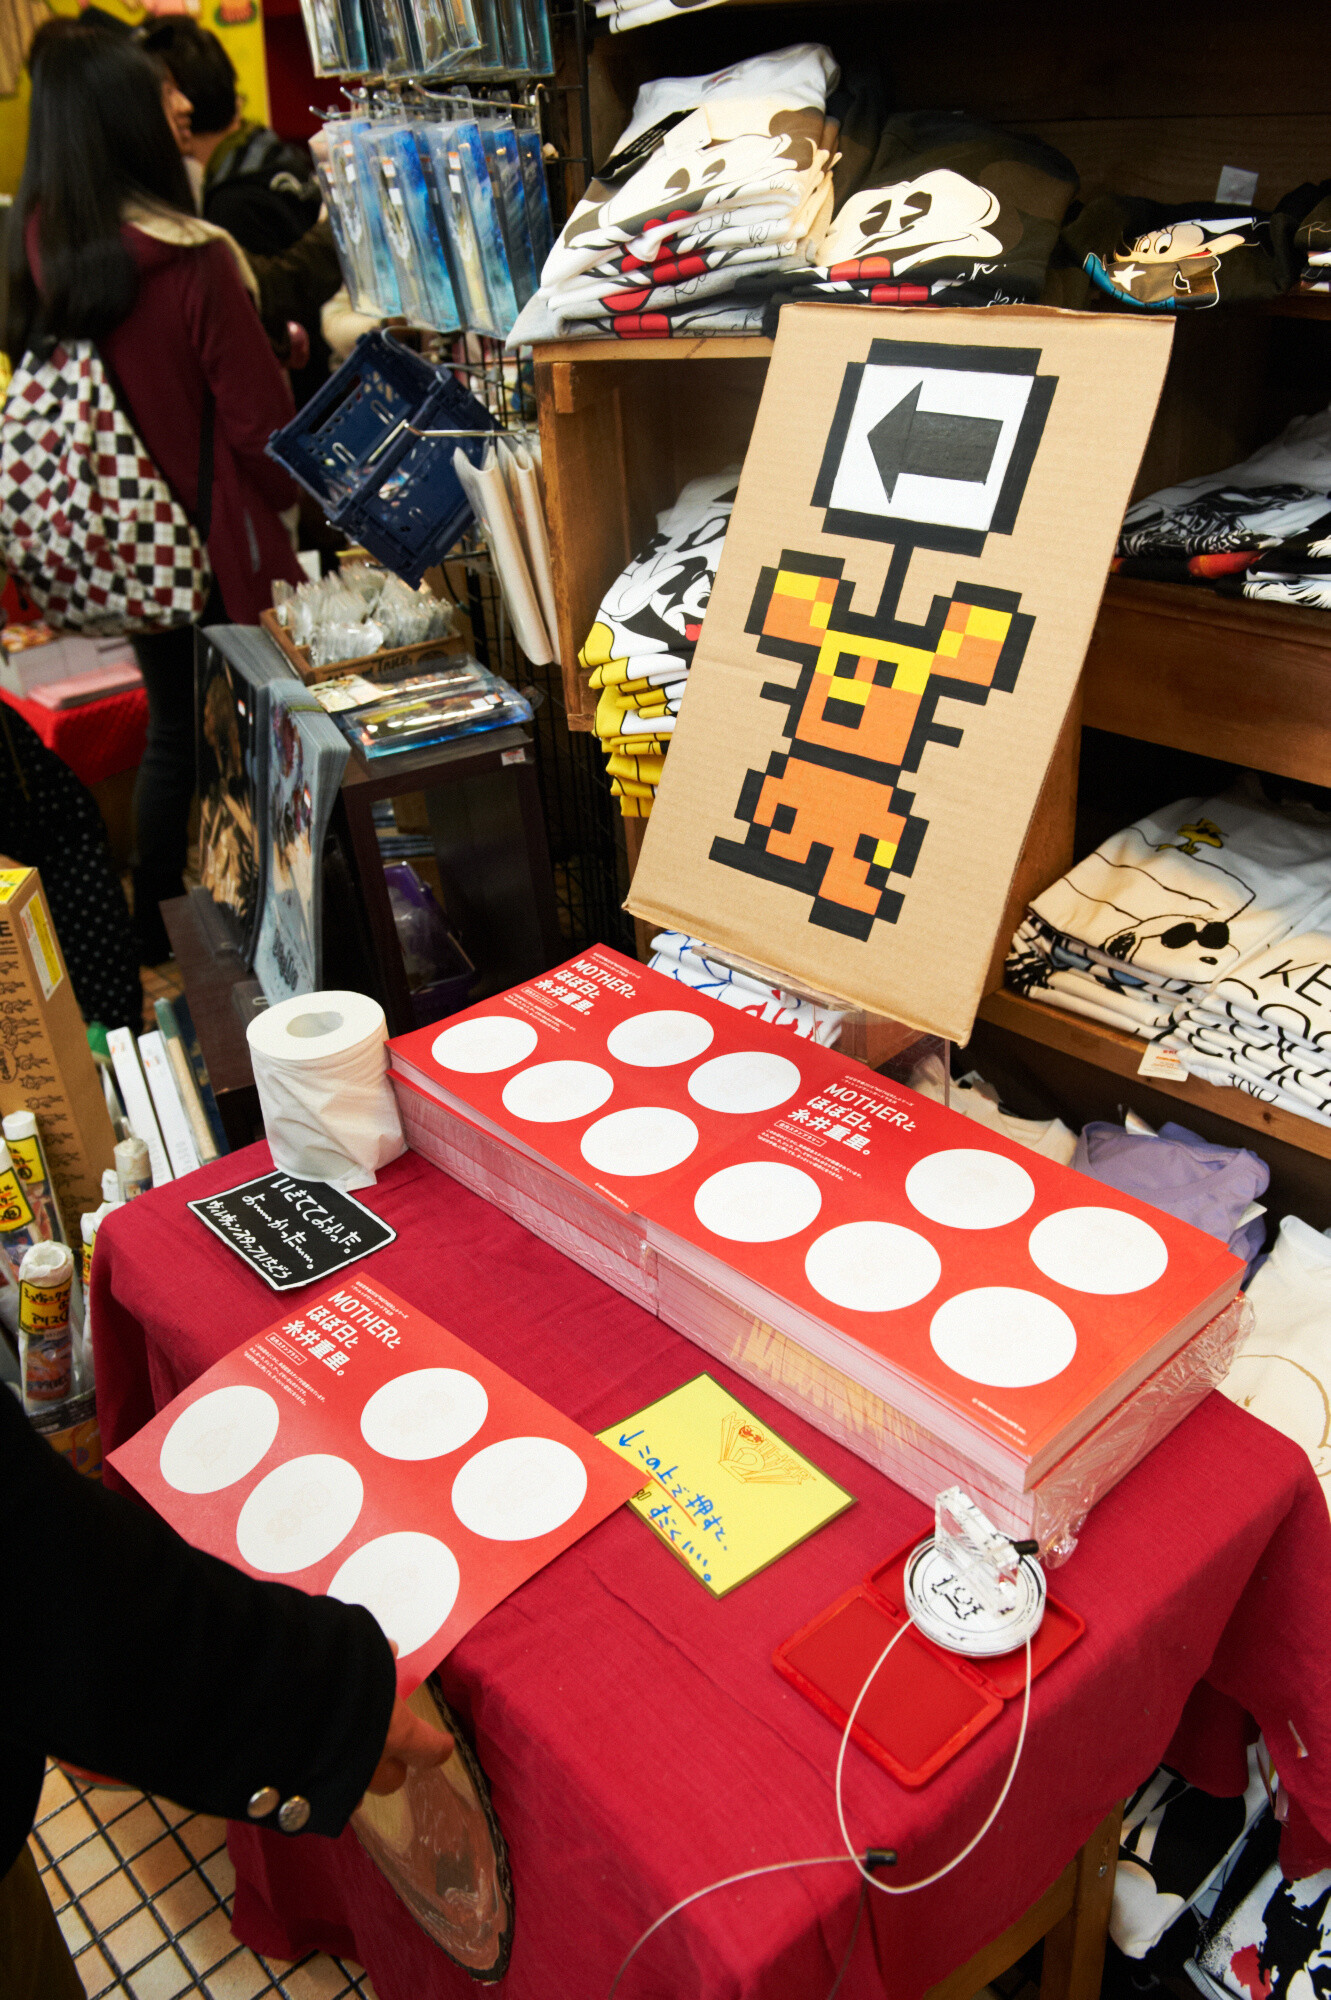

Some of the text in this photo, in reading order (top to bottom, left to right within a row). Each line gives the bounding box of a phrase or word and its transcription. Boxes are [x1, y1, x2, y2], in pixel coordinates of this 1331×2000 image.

[554, 969, 600, 999] ほぼ日と
[571, 959, 636, 999] MOTHERと
[806, 1096, 872, 1132] ほぼ日と
[823, 1083, 916, 1132] MOTHERと
[787, 1109, 871, 1155] 糸井重里。
[305, 1305, 358, 1349] ほぼ日と
[328, 1290, 401, 1349] MOTHERと
[282, 1320, 350, 1376] 糸井重里。
